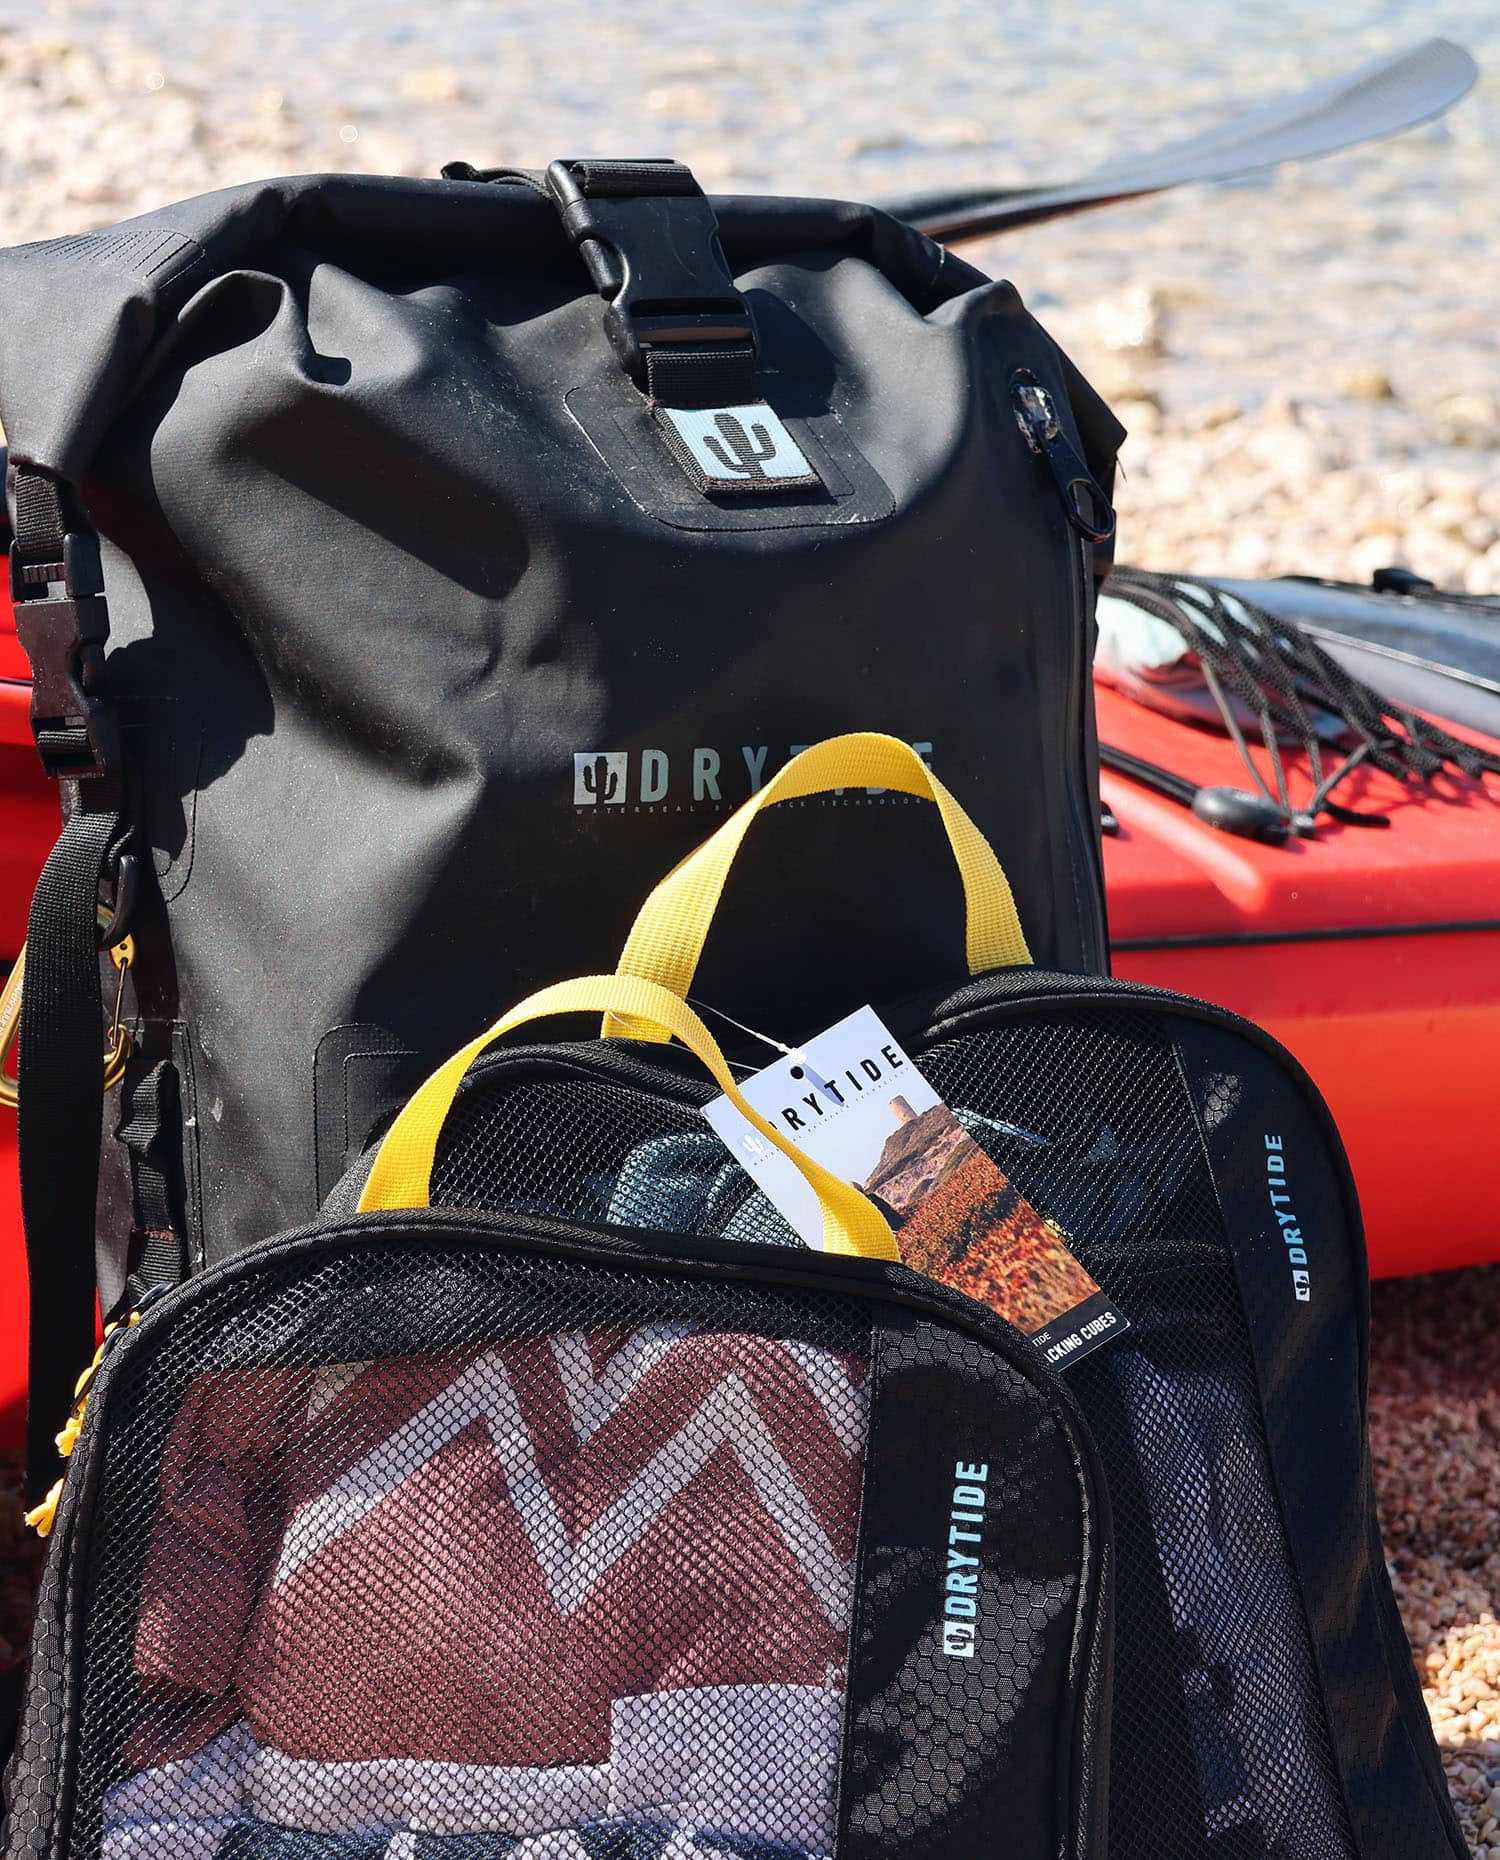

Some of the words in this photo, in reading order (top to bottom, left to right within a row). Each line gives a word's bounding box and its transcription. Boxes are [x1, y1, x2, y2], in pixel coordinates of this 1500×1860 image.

[714, 801, 805, 811] BAACK
[821, 798, 921, 808] TECHNOLOG
[768, 1045, 904, 1132] RYTIDE
[1264, 1134, 1308, 1265] DRYTIDE
[1080, 1311, 1117, 1340] CUBES
[944, 1461, 988, 1618] DRYTIDE
